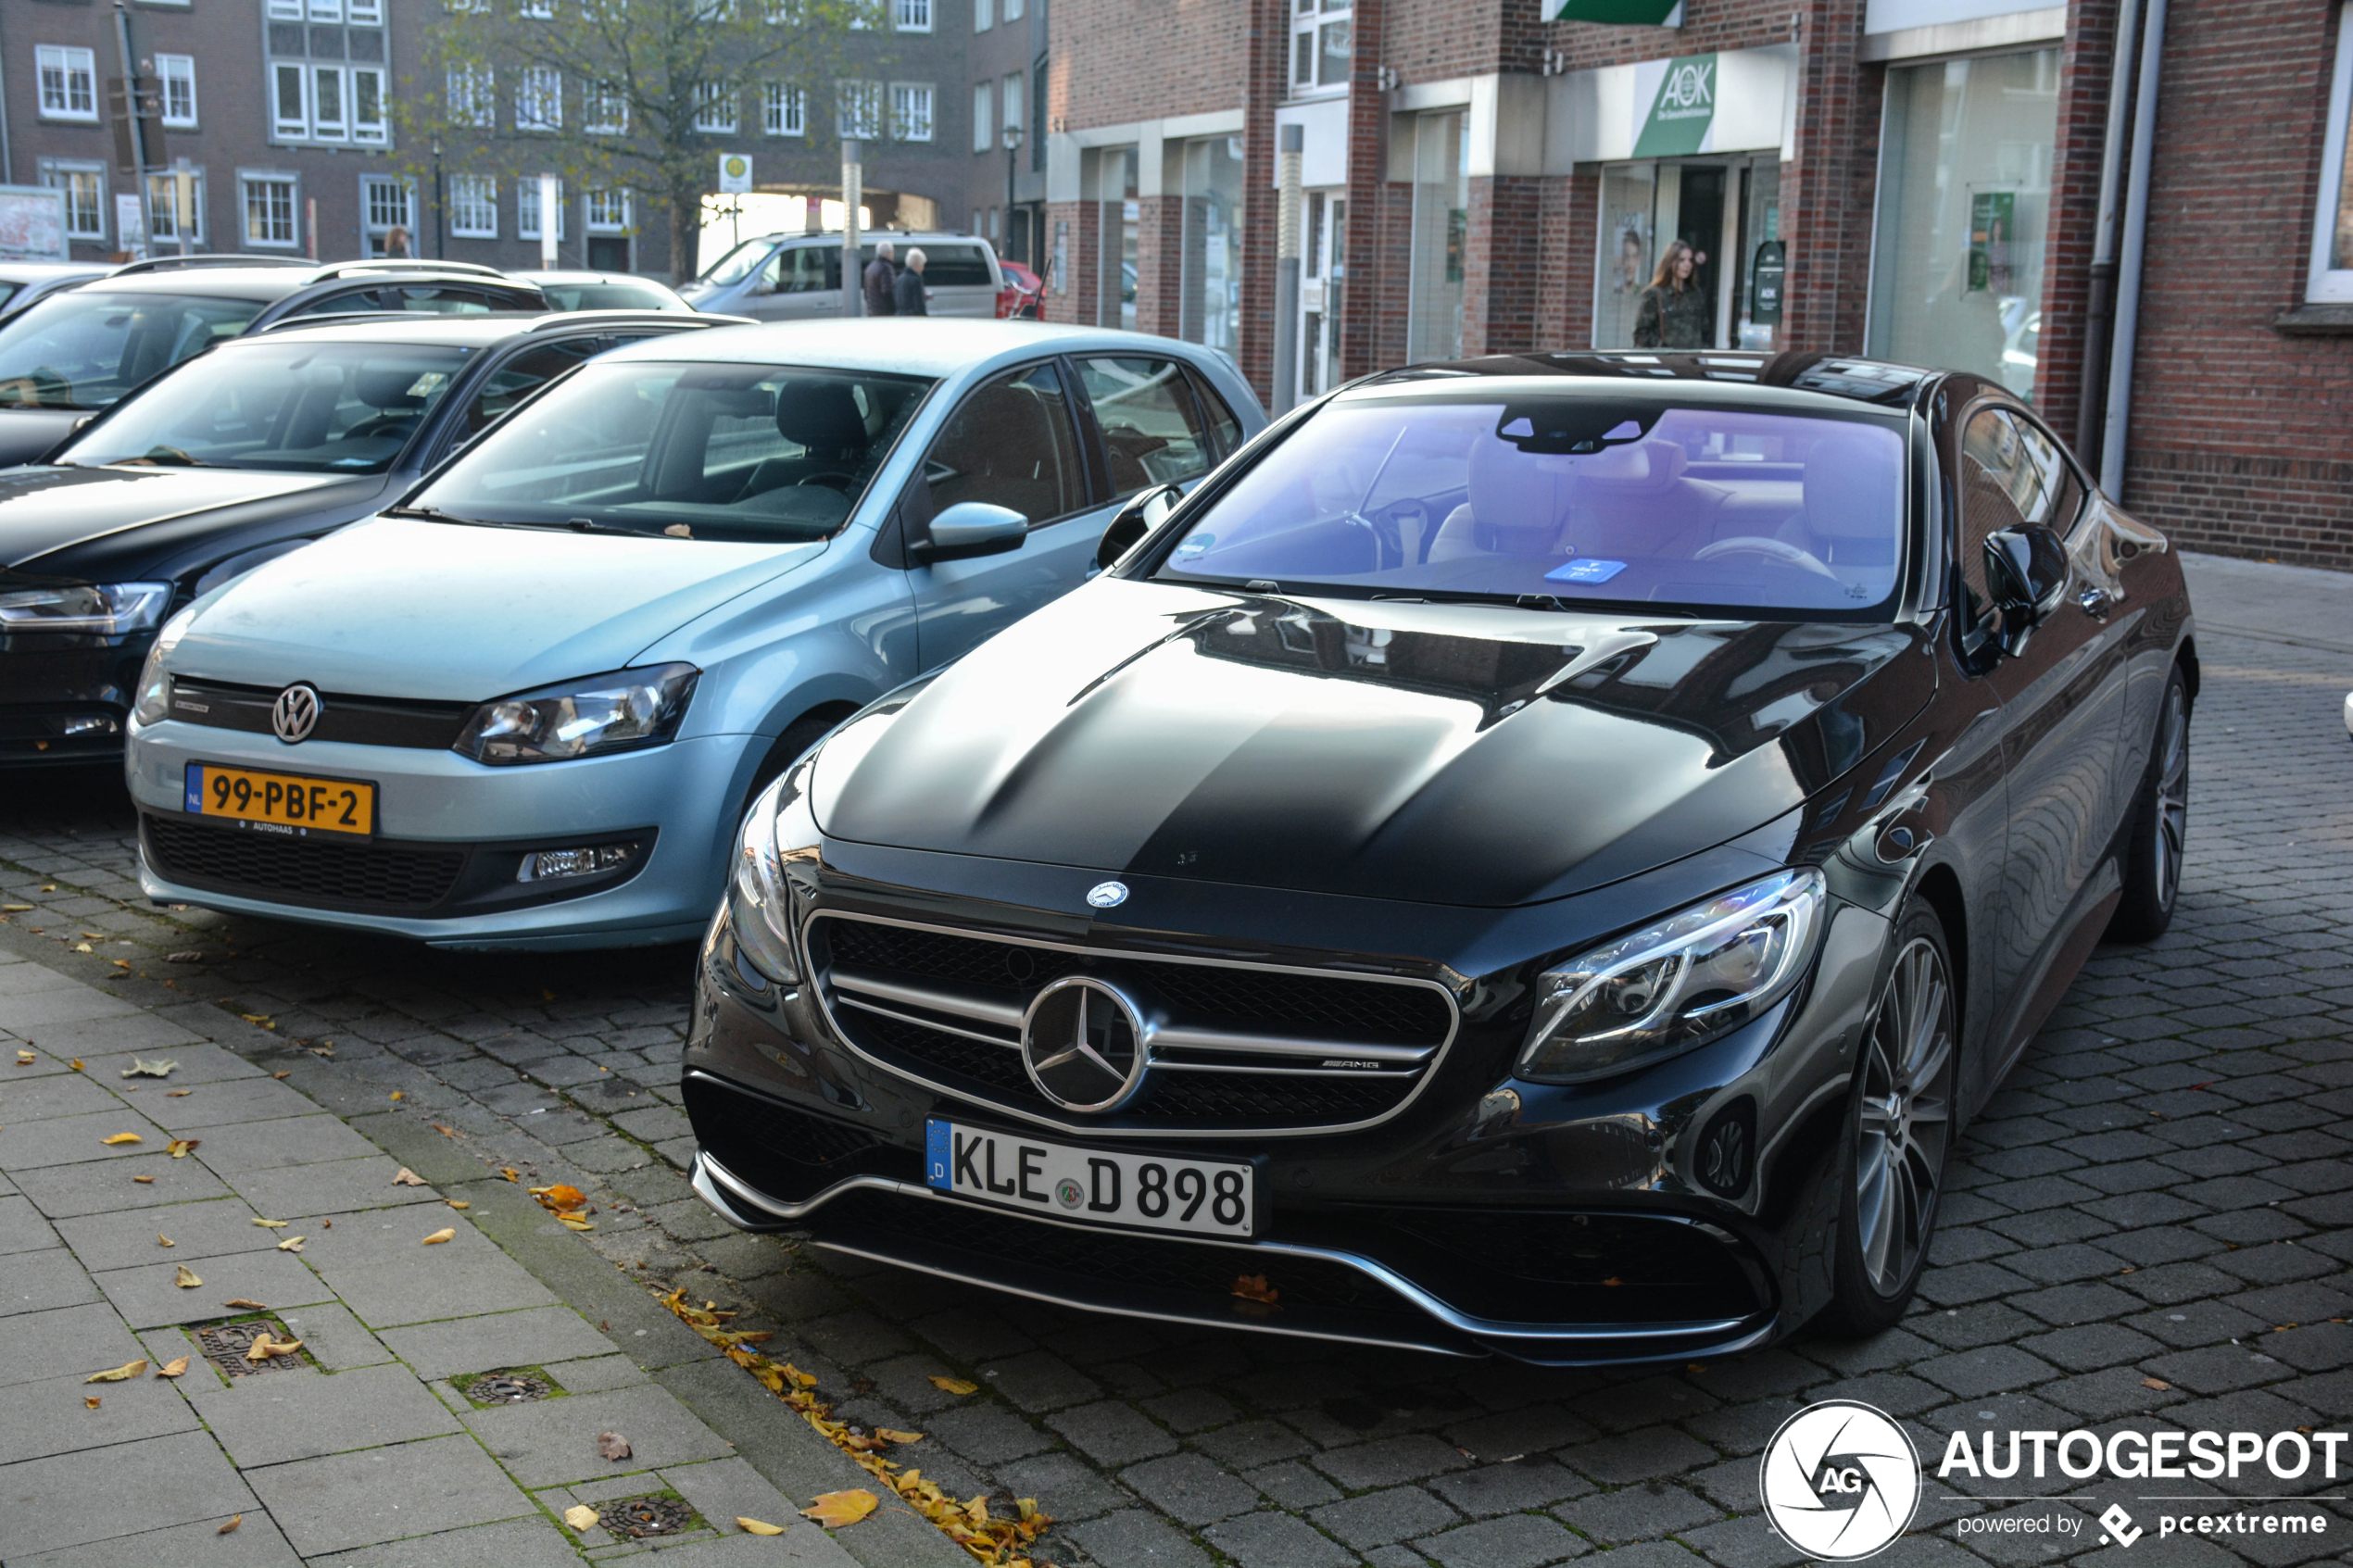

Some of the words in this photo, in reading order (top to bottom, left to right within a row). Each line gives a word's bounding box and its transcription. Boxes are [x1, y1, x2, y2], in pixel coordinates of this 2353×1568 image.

[1660, 62, 1713, 108] AOK
[188, 793, 201, 806] NL
[212, 774, 358, 826] 99-PBF-2
[253, 822, 293, 834] AUTOHAAS
[934, 1162, 944, 1178] D
[954, 1132, 1050, 1203] KLE
[1088, 1157, 1122, 1213] D
[1137, 1162, 1246, 1226] 898
